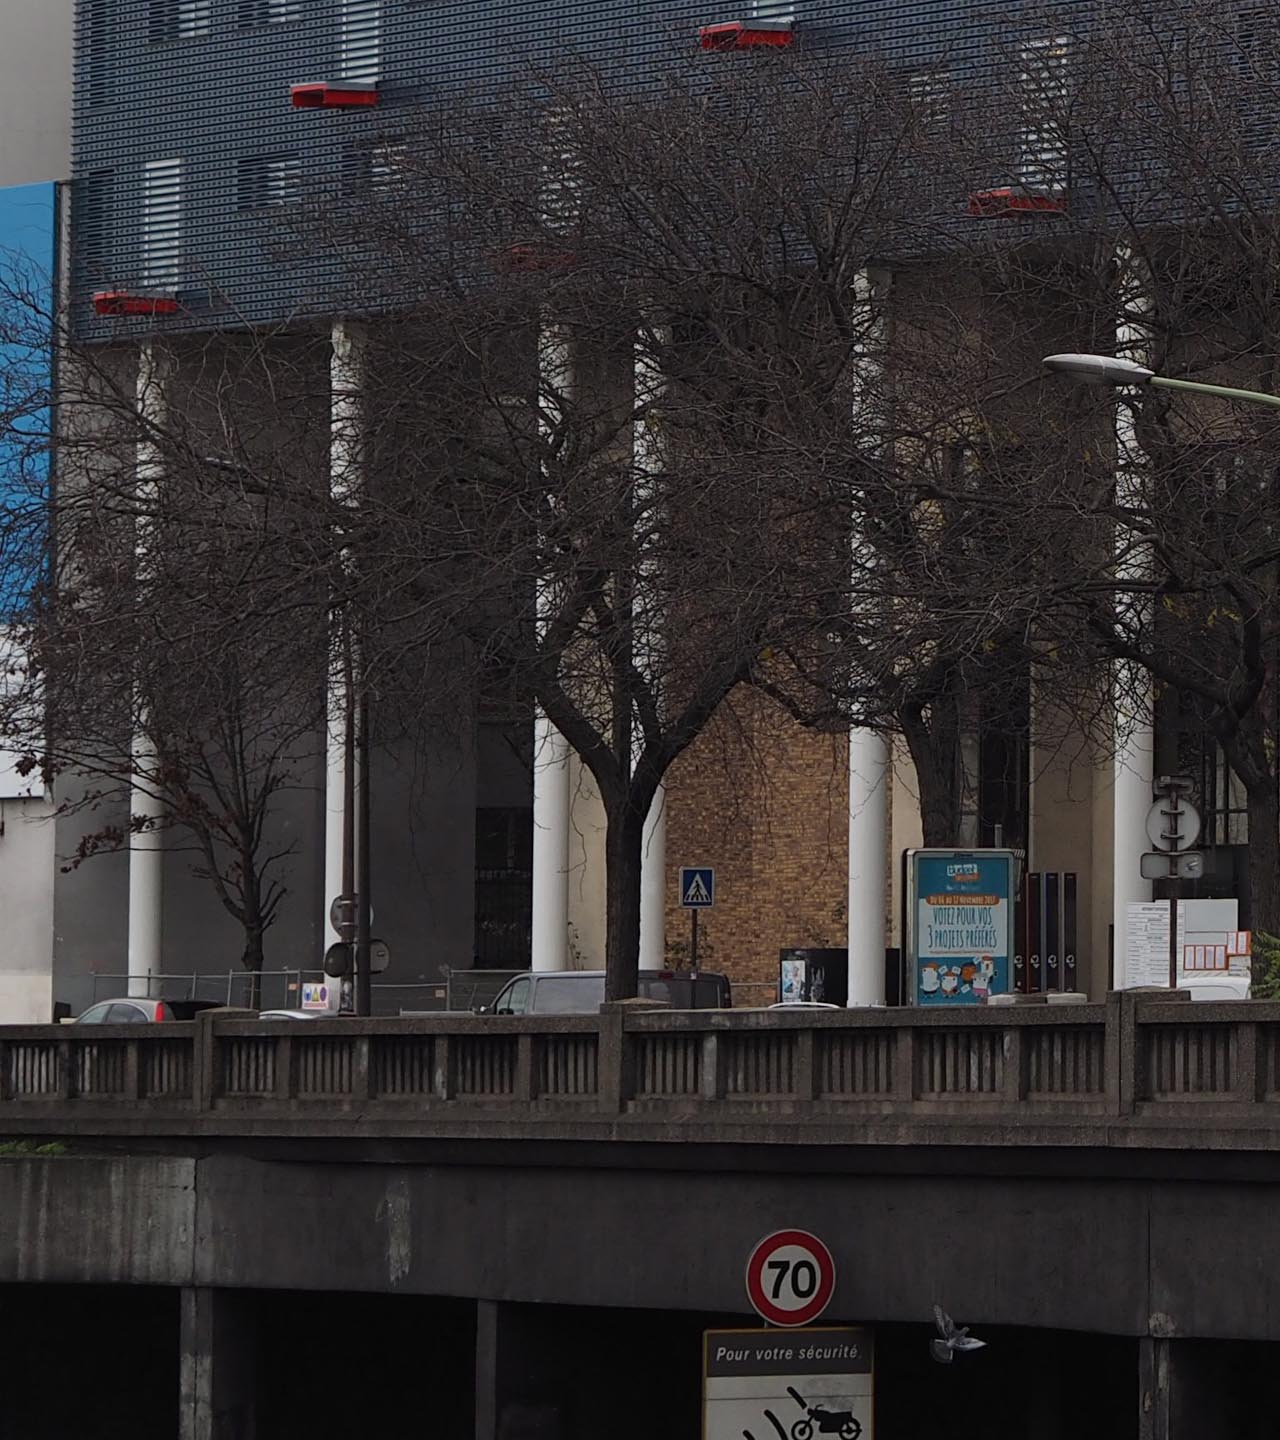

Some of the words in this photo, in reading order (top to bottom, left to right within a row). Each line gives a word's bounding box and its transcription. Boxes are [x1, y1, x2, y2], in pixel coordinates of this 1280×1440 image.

[933, 907, 954, 925] VOTEZ
[956, 907, 976, 925] POUR
[978, 907, 993, 925] VOS
[928, 924, 933, 948] 3
[934, 929, 964, 950] PROJETS
[966, 925, 997, 949] PRÉFÉRÉS
[767, 1260, 817, 1299] 70
[716, 1346, 750, 1362] Pour
[755, 1347, 793, 1360] votre
